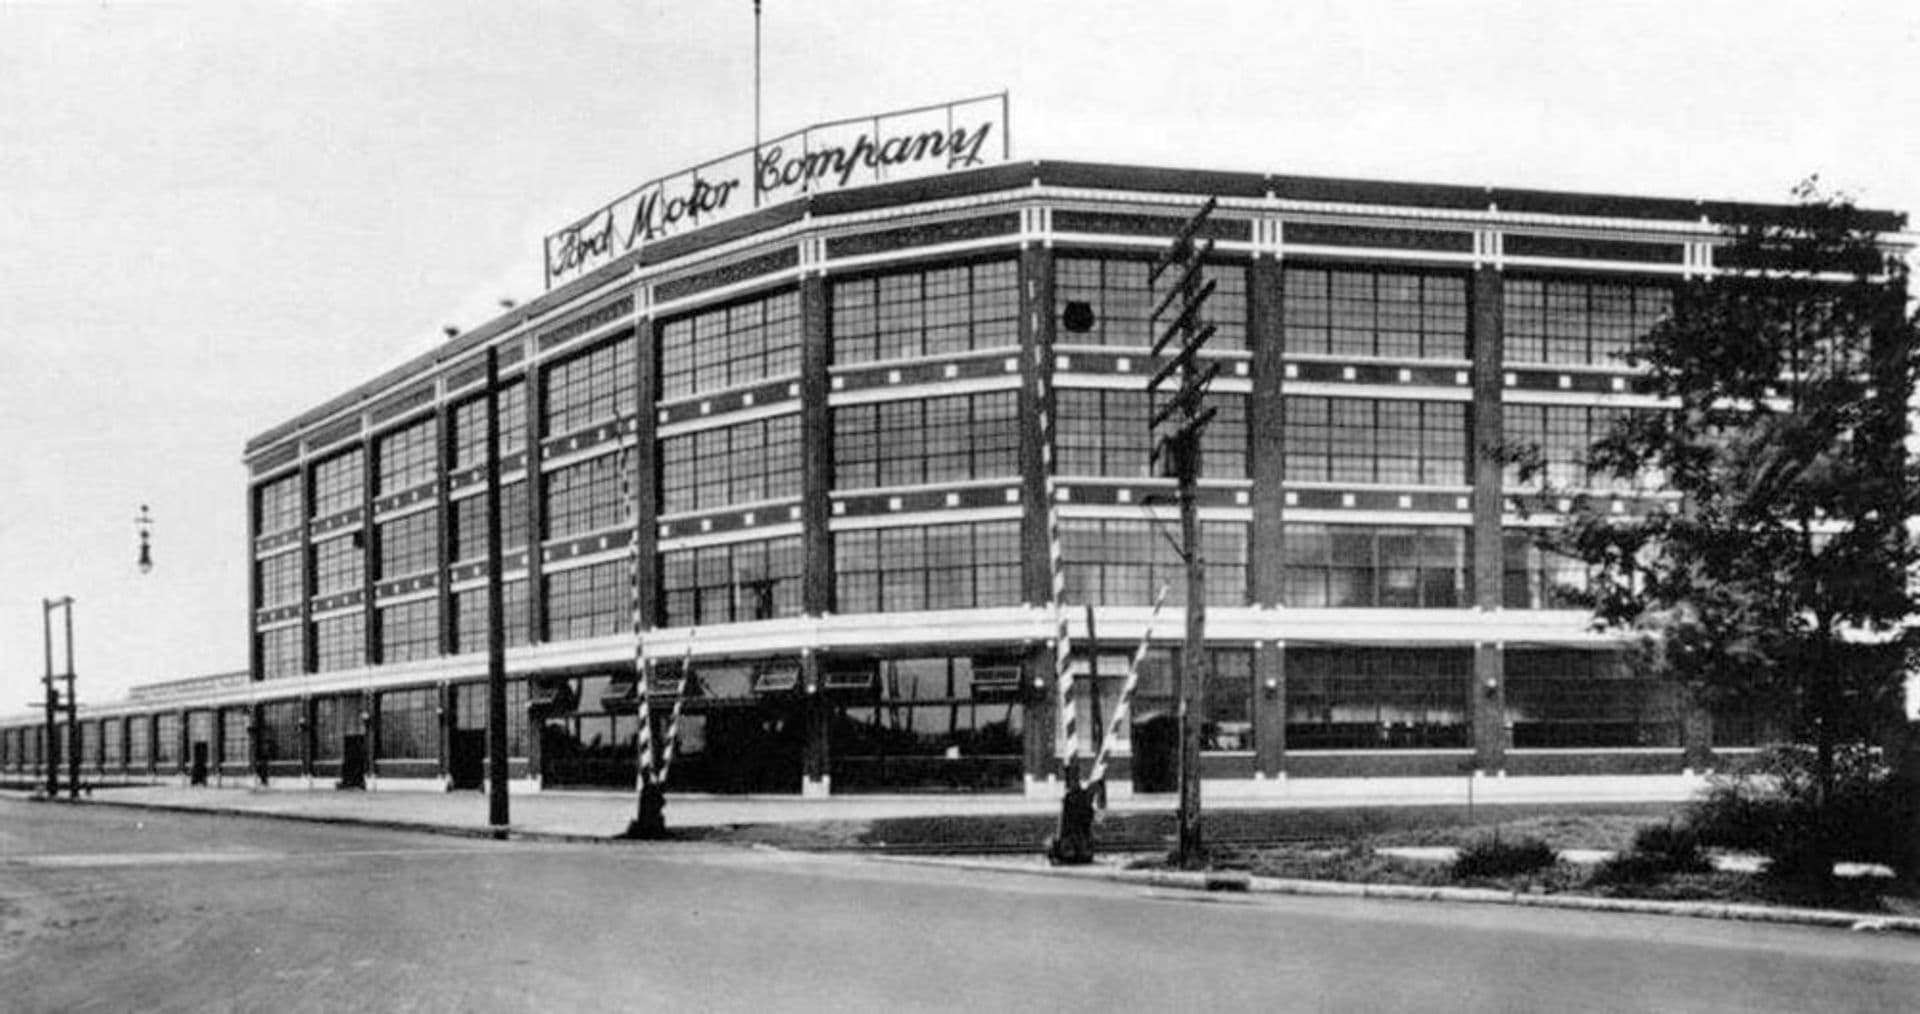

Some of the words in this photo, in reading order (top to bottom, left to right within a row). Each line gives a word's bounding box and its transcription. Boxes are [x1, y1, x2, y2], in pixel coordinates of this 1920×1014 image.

[552, 212, 613, 275] Ford
[626, 179, 739, 249] Motor
[757, 121, 992, 192] Company
